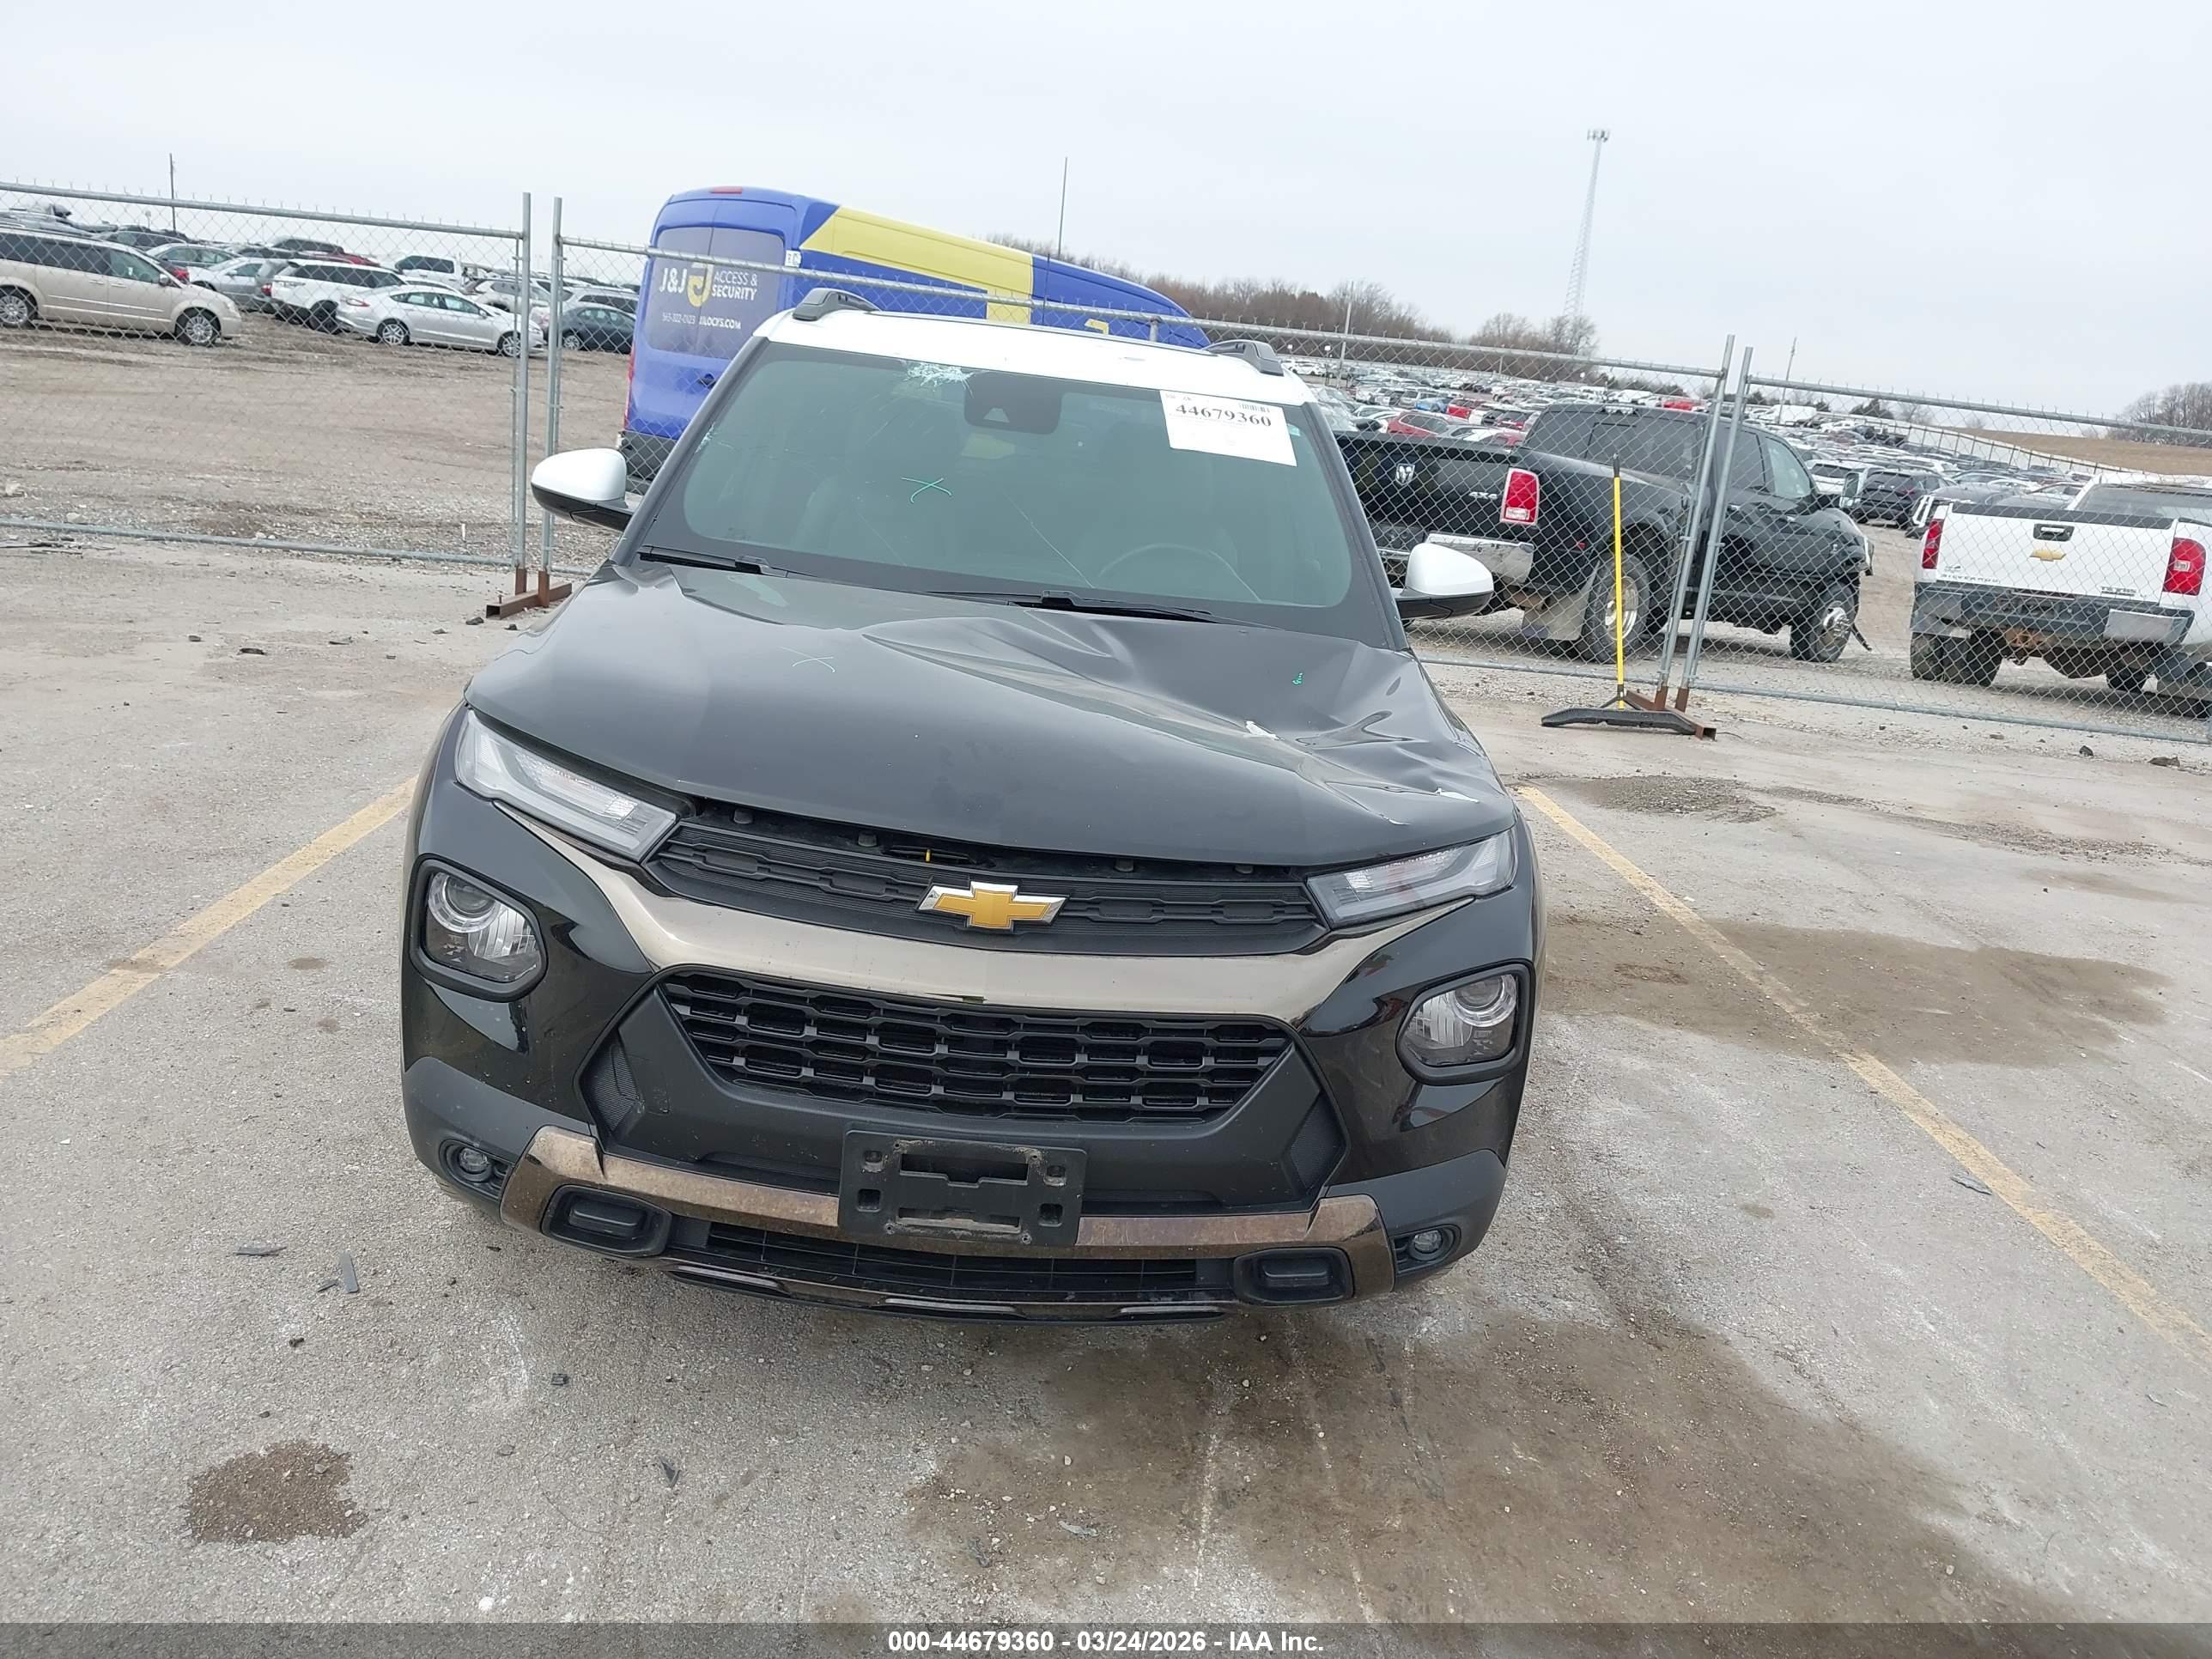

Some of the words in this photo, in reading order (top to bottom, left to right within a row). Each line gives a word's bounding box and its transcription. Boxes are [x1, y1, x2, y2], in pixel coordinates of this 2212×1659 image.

[659, 268, 687, 294] J&J
[714, 270, 749, 284] ACCESS
[750, 273, 758, 287] &
[712, 284, 757, 301] SECURITY
[1175, 404, 1272, 427] 44679360
